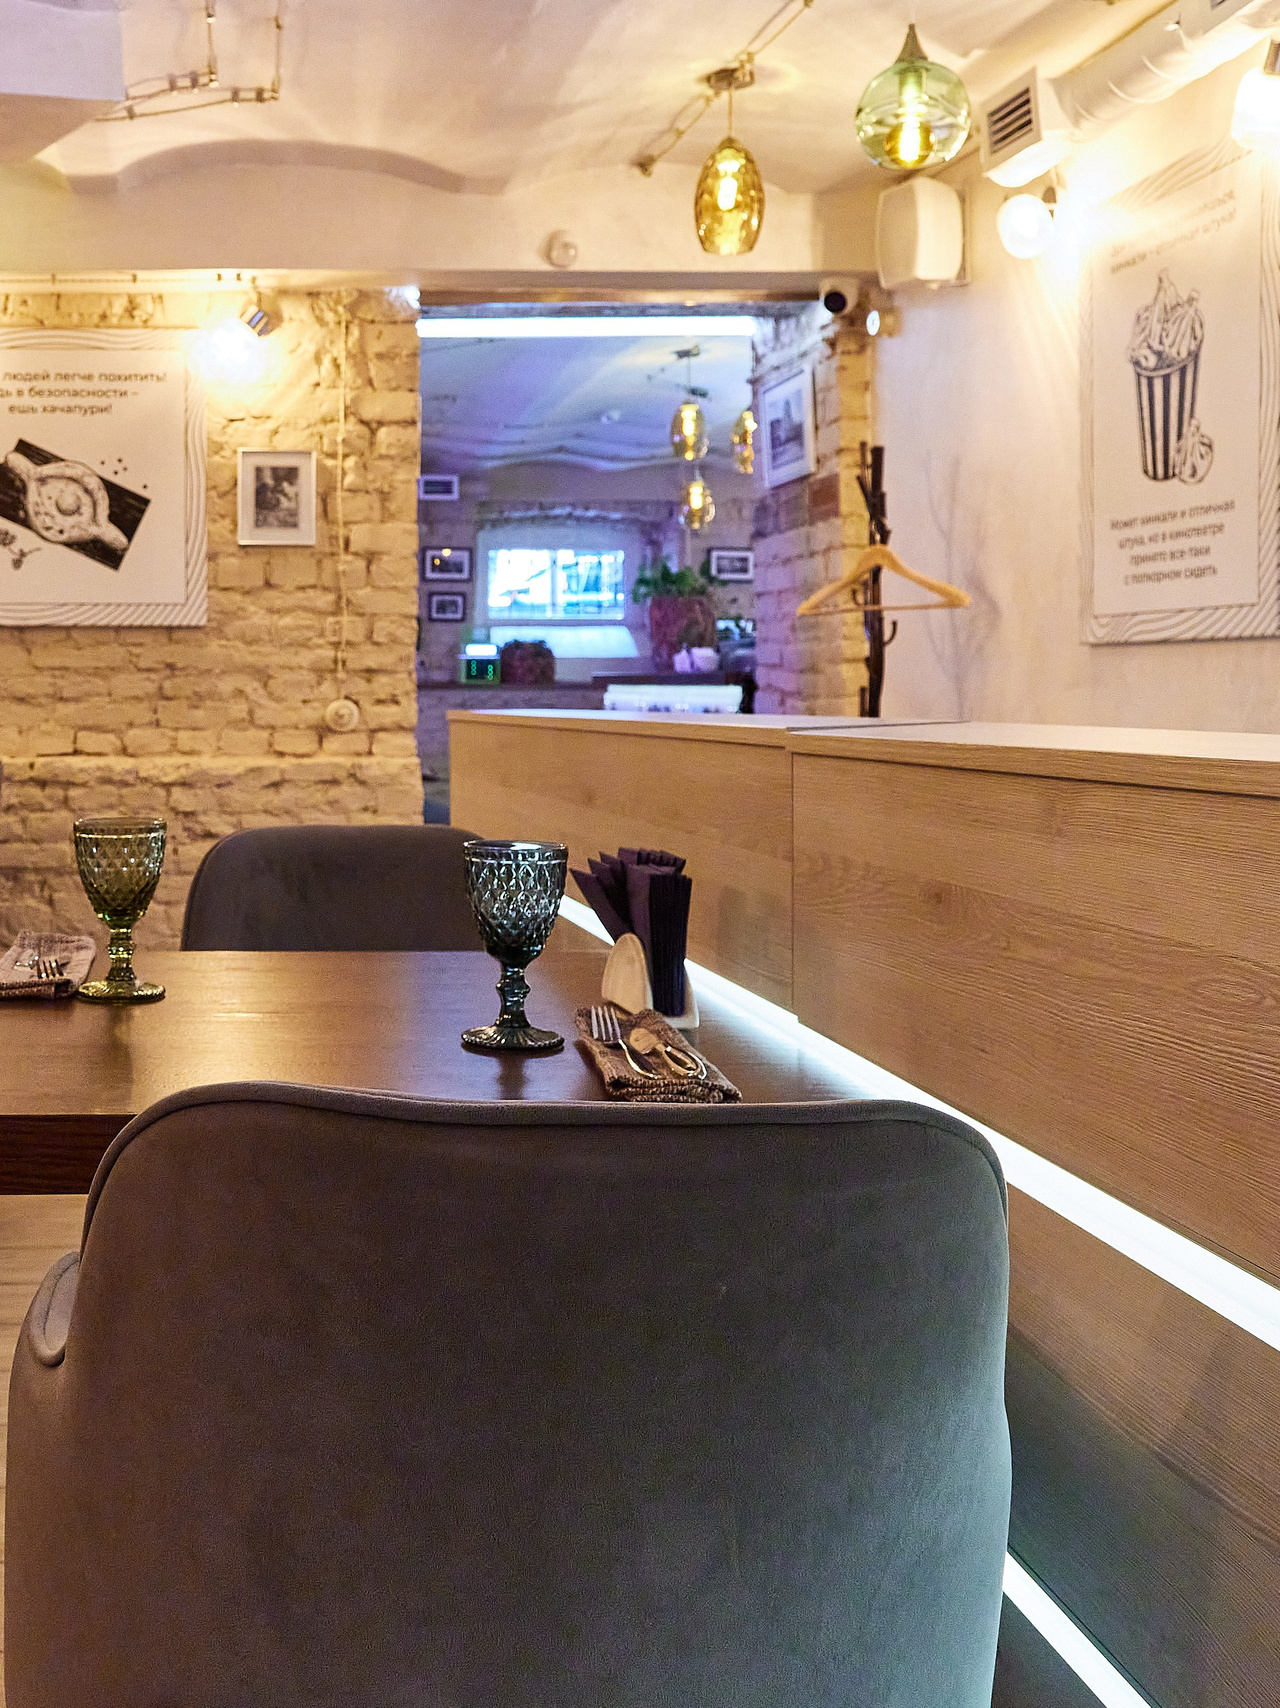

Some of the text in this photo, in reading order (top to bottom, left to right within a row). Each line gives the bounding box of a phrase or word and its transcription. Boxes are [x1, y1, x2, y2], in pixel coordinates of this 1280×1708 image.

[3, 368, 50, 382] людей
[54, 371, 94, 381] легче
[17, 388, 24, 397] в
[28, 385, 127, 398] безопасности
[8, 402, 112, 417] ешь хачапури!
